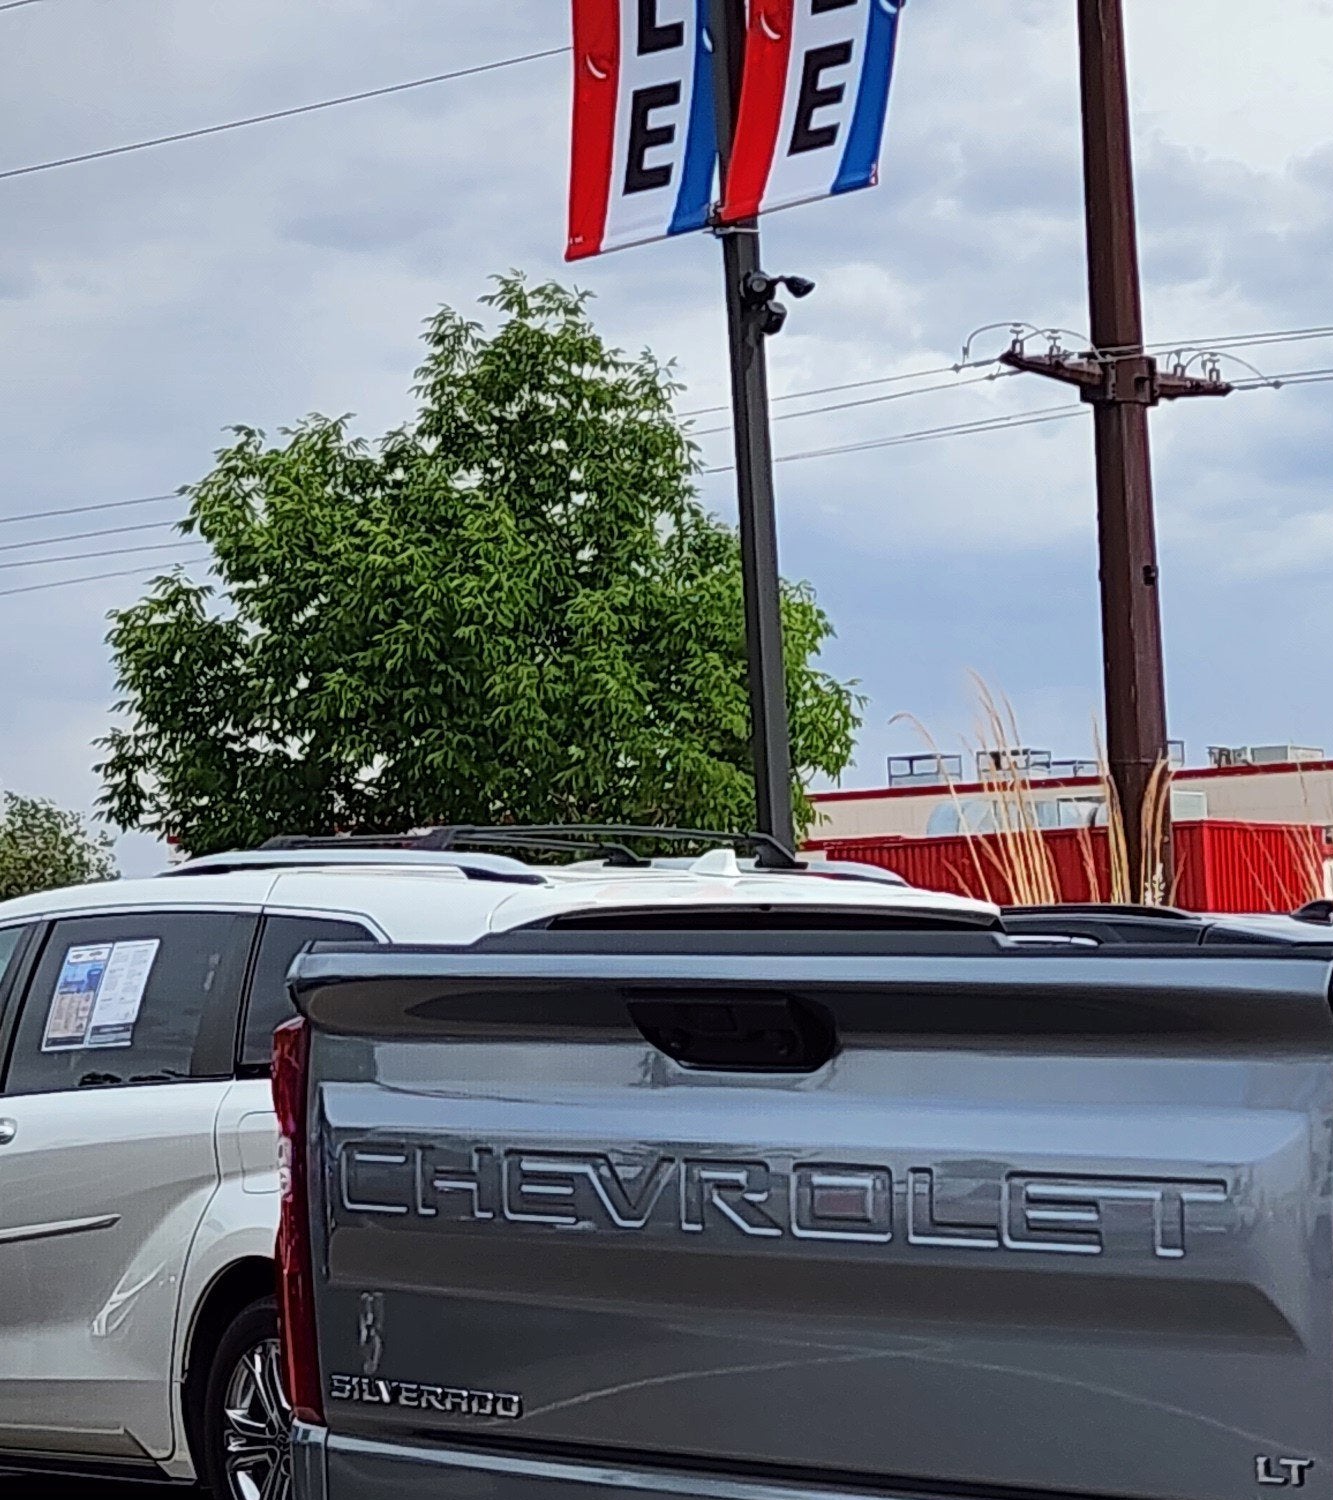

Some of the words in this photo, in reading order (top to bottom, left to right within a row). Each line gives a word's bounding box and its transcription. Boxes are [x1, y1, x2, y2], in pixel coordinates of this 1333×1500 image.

[622, 0, 685, 197] LE
[338, 1141, 1230, 1259] CHEVROLET
[330, 1373, 524, 1419] SILVERADO
[1254, 1456, 1316, 1486] LT
